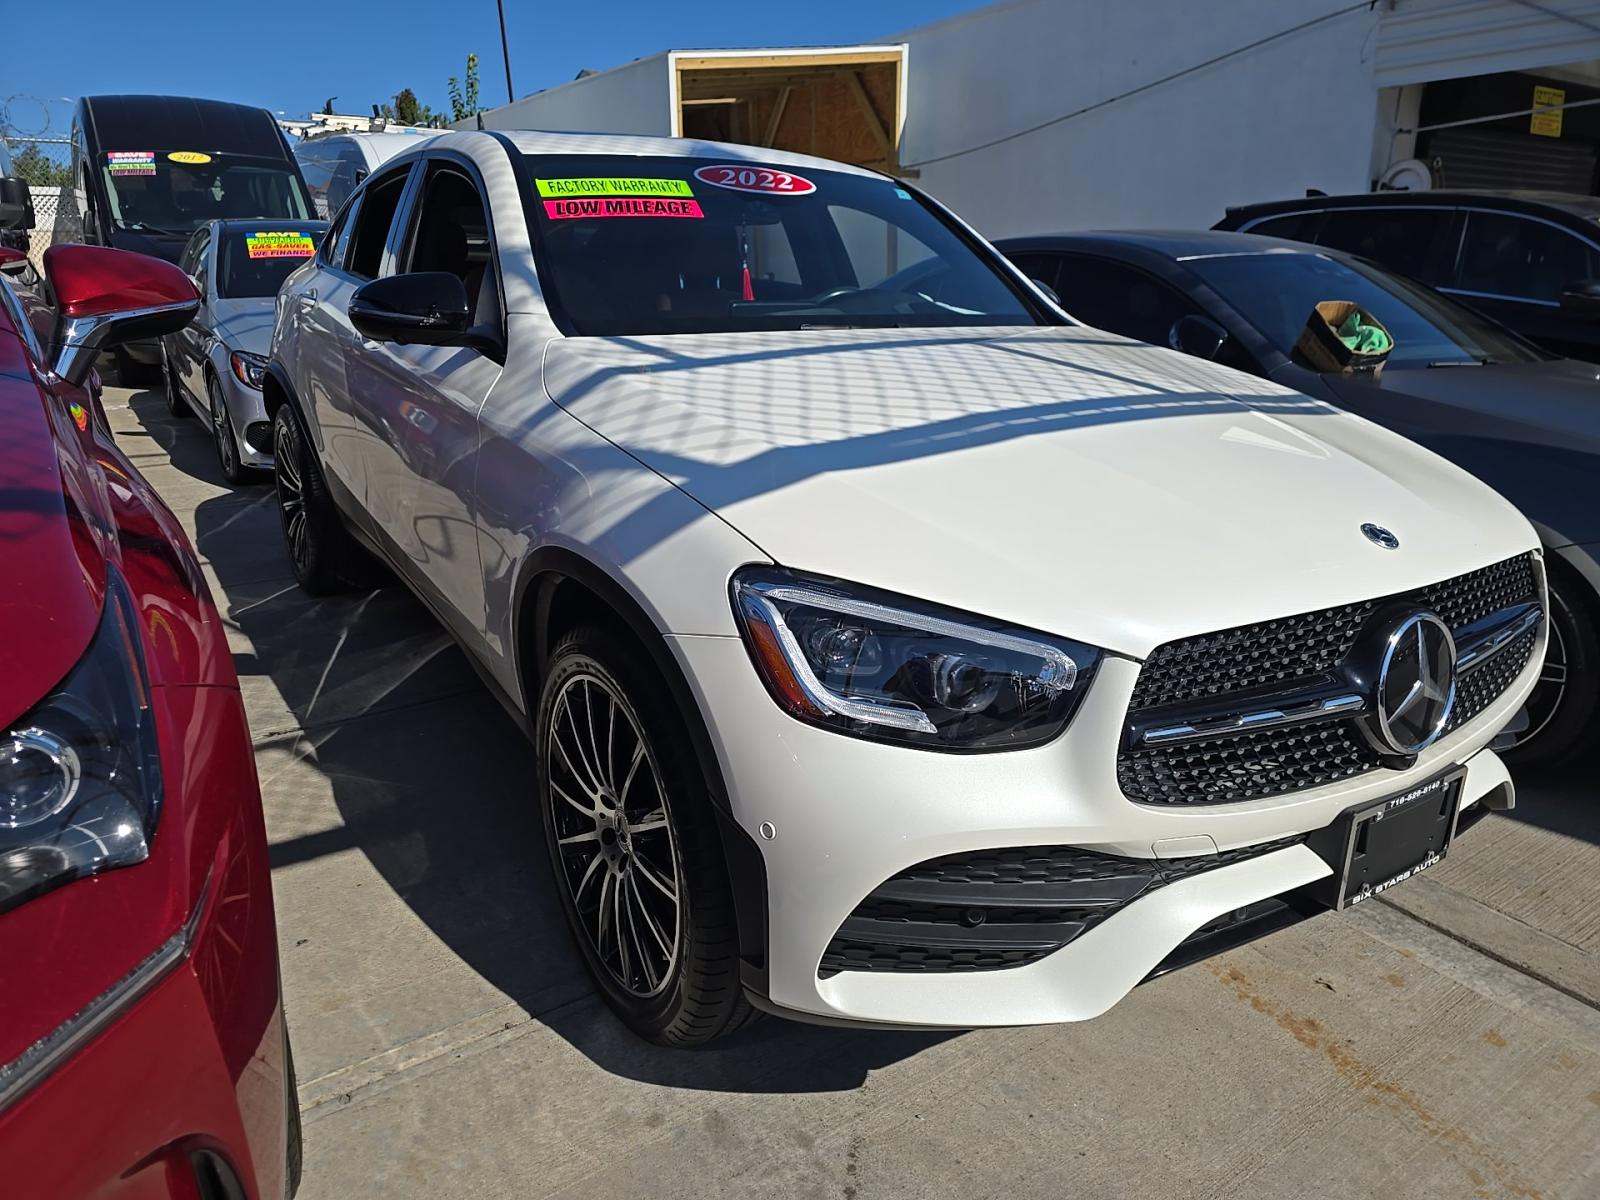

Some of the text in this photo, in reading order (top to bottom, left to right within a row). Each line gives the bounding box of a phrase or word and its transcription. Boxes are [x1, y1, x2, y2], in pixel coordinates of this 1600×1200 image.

[547, 180, 683, 193] FACTORY WARRANTY
[720, 169, 794, 190] 2022
[555, 200, 693, 216] LOW MILEAGE
[1375, 870, 1411, 894] STARS
[1412, 854, 1440, 875] AUTO
